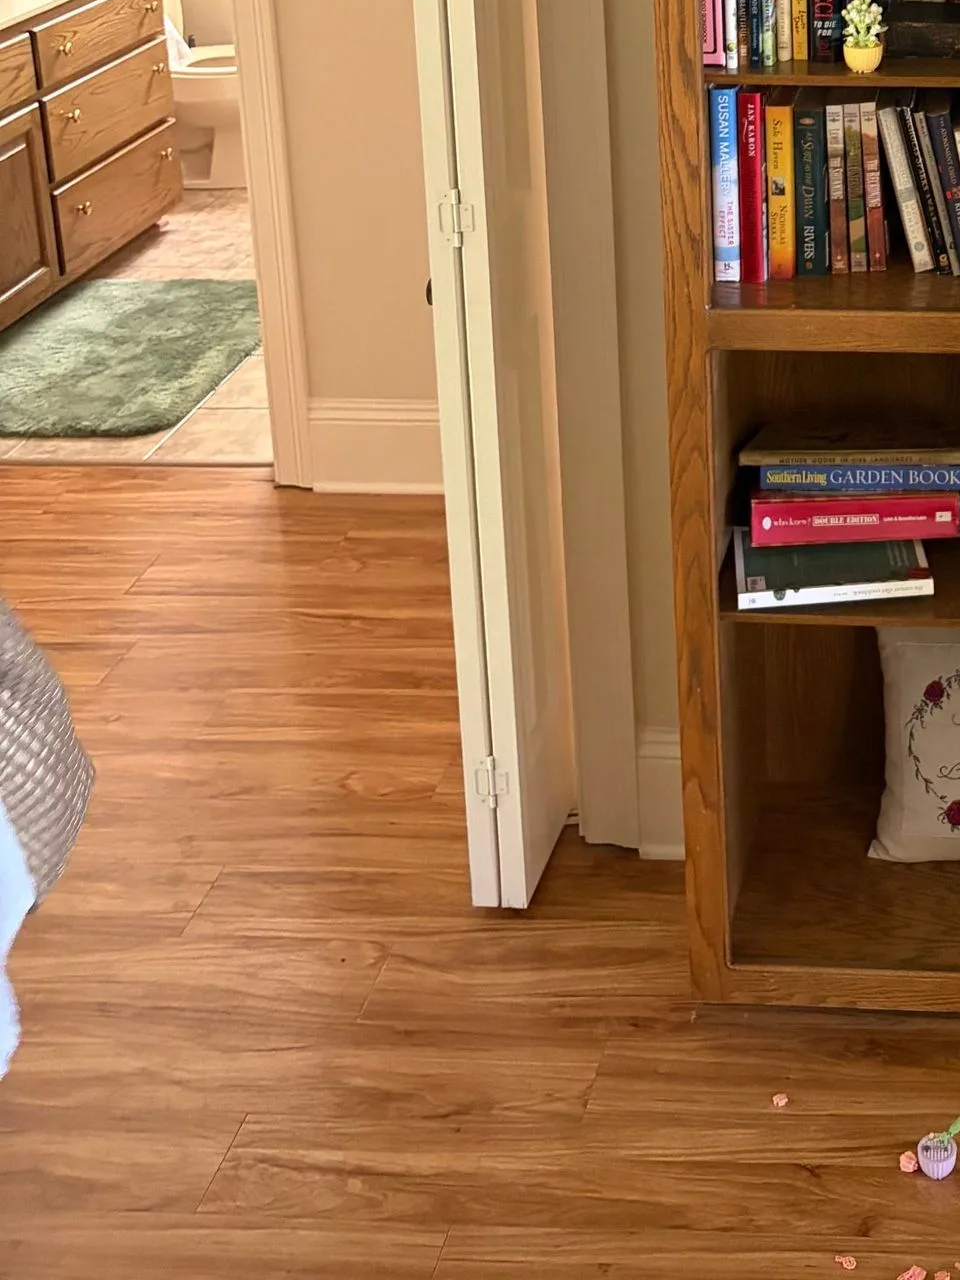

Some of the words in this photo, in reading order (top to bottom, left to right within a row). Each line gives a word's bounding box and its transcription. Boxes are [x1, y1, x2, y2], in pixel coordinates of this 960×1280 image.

[817, 29, 833, 37] FOR
[718, 96, 728, 138] SUSAN
[772, 119, 783, 137] Safe
[748, 124, 756, 157] KARON
[773, 141, 783, 170] Haven
[802, 140, 815, 162] SURE
[941, 125, 953, 165] ATONEMENT
[803, 185, 815, 219] DAWN
[866, 172, 880, 207] RECKONING
[804, 225, 815, 260] RIVERS
[766, 470, 804, 483] Southern
[804, 470, 827, 485] Living
[830, 470, 903, 484] GARDEN
[908, 470, 960, 485] BOOK
[846, 515, 878, 524] EDITION
